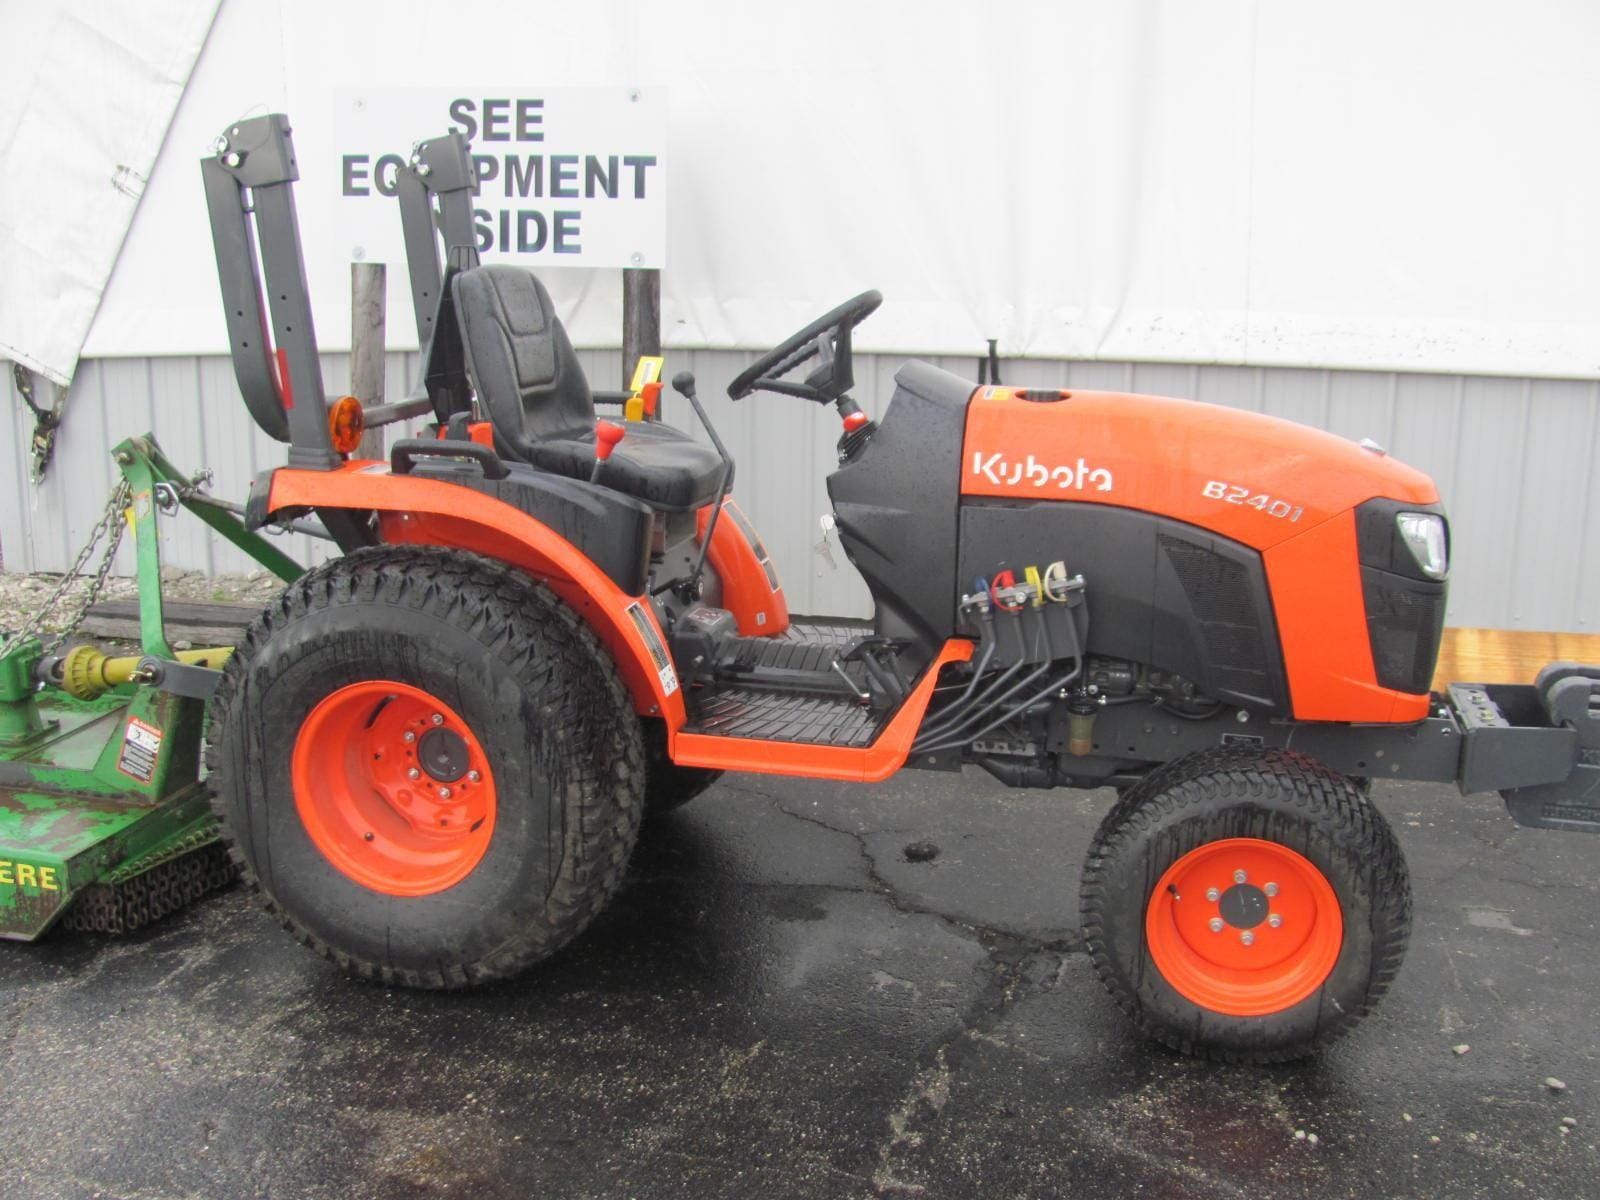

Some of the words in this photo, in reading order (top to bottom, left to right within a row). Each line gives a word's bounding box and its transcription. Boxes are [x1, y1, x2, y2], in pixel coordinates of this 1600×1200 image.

[449, 98, 544, 142] SEE
[342, 153, 657, 199] EQPMENT
[433, 209, 582, 253] SIDE
[973, 452, 1112, 491] Kubota
[1202, 480, 1304, 522] B2401
